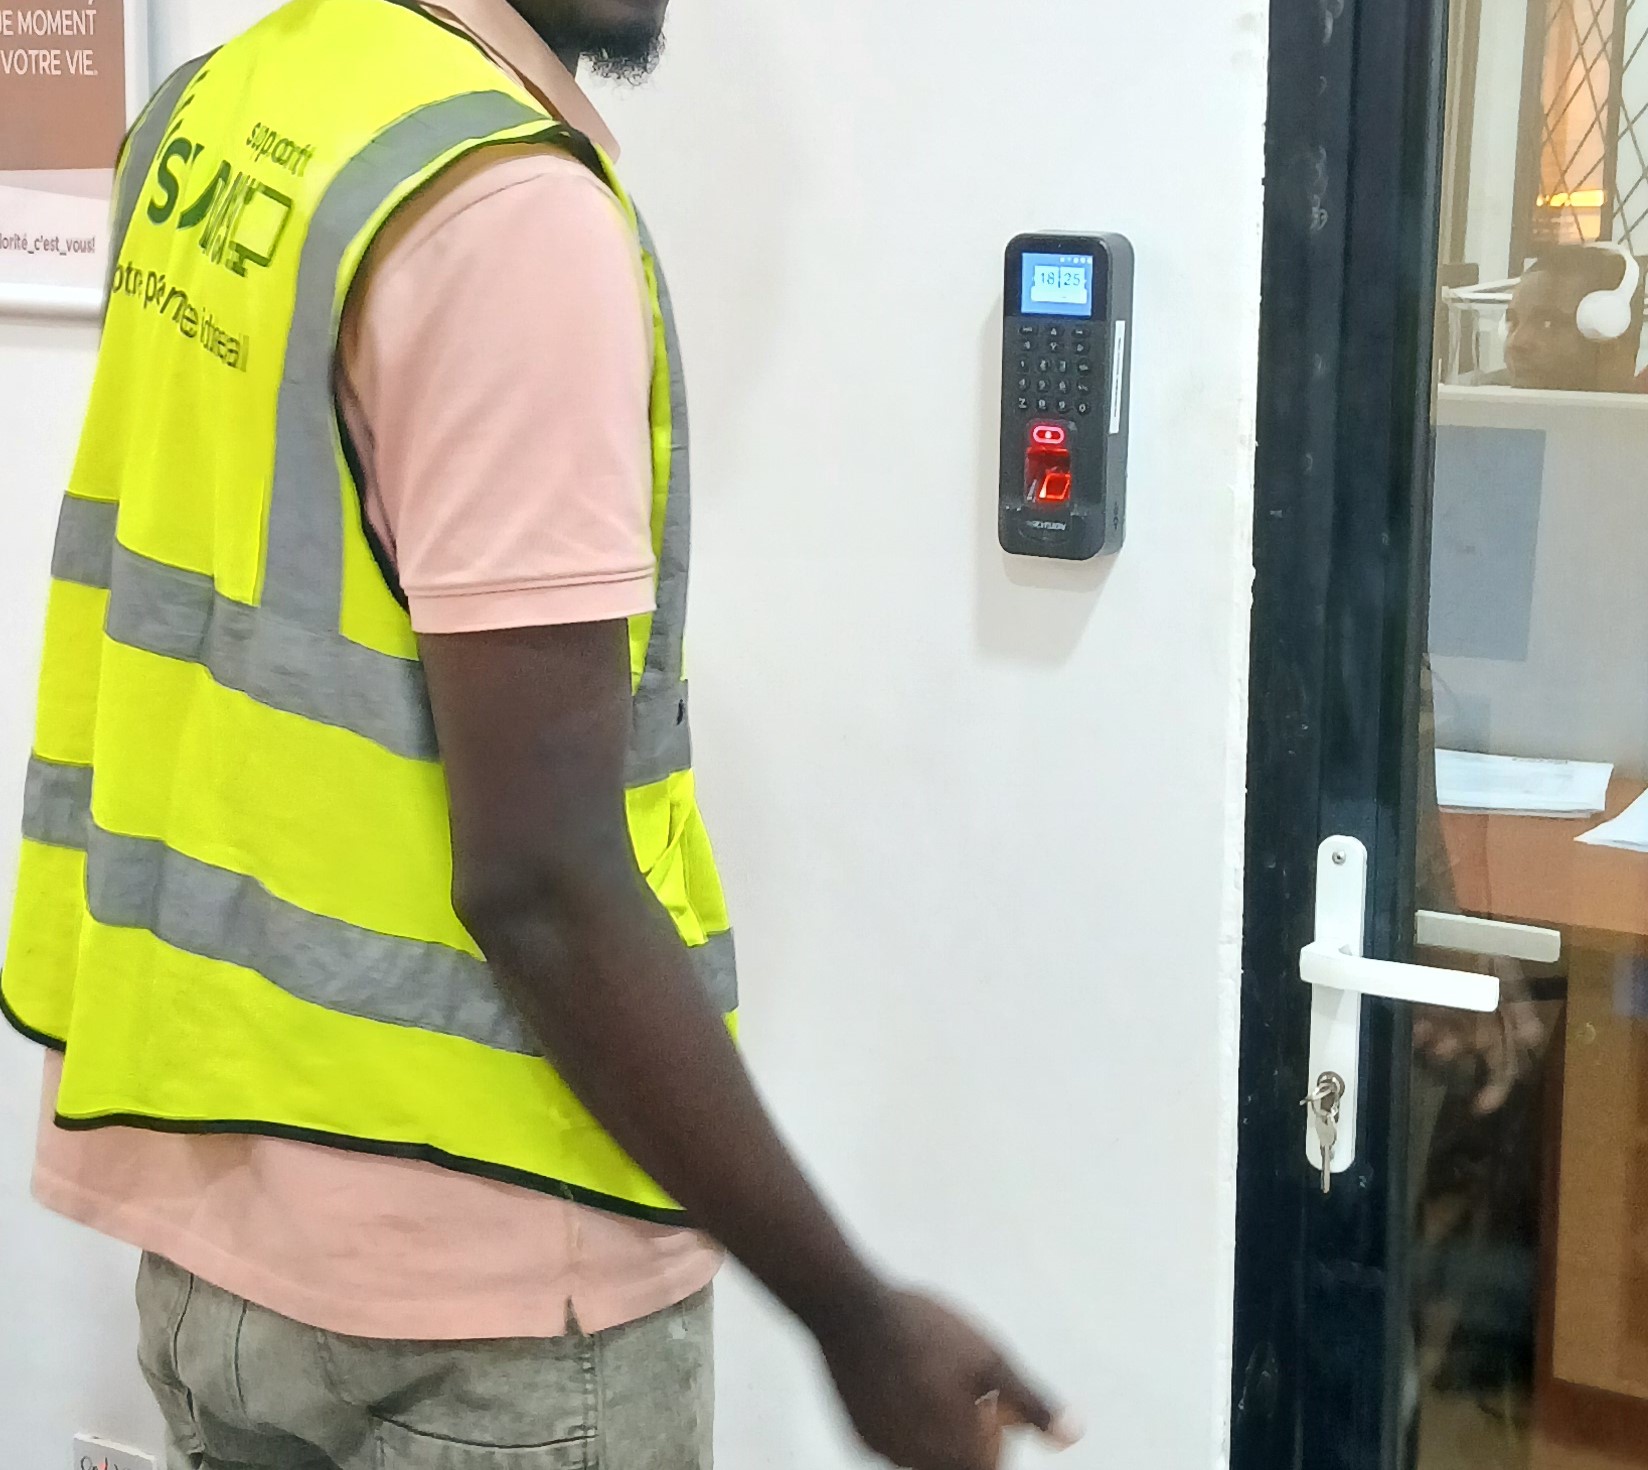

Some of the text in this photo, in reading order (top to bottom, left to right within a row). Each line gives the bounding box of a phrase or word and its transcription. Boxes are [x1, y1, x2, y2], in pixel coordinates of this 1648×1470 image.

[0, 9, 97, 35] E MOMENT
[0, 49, 98, 75] VOTRE VIE.
